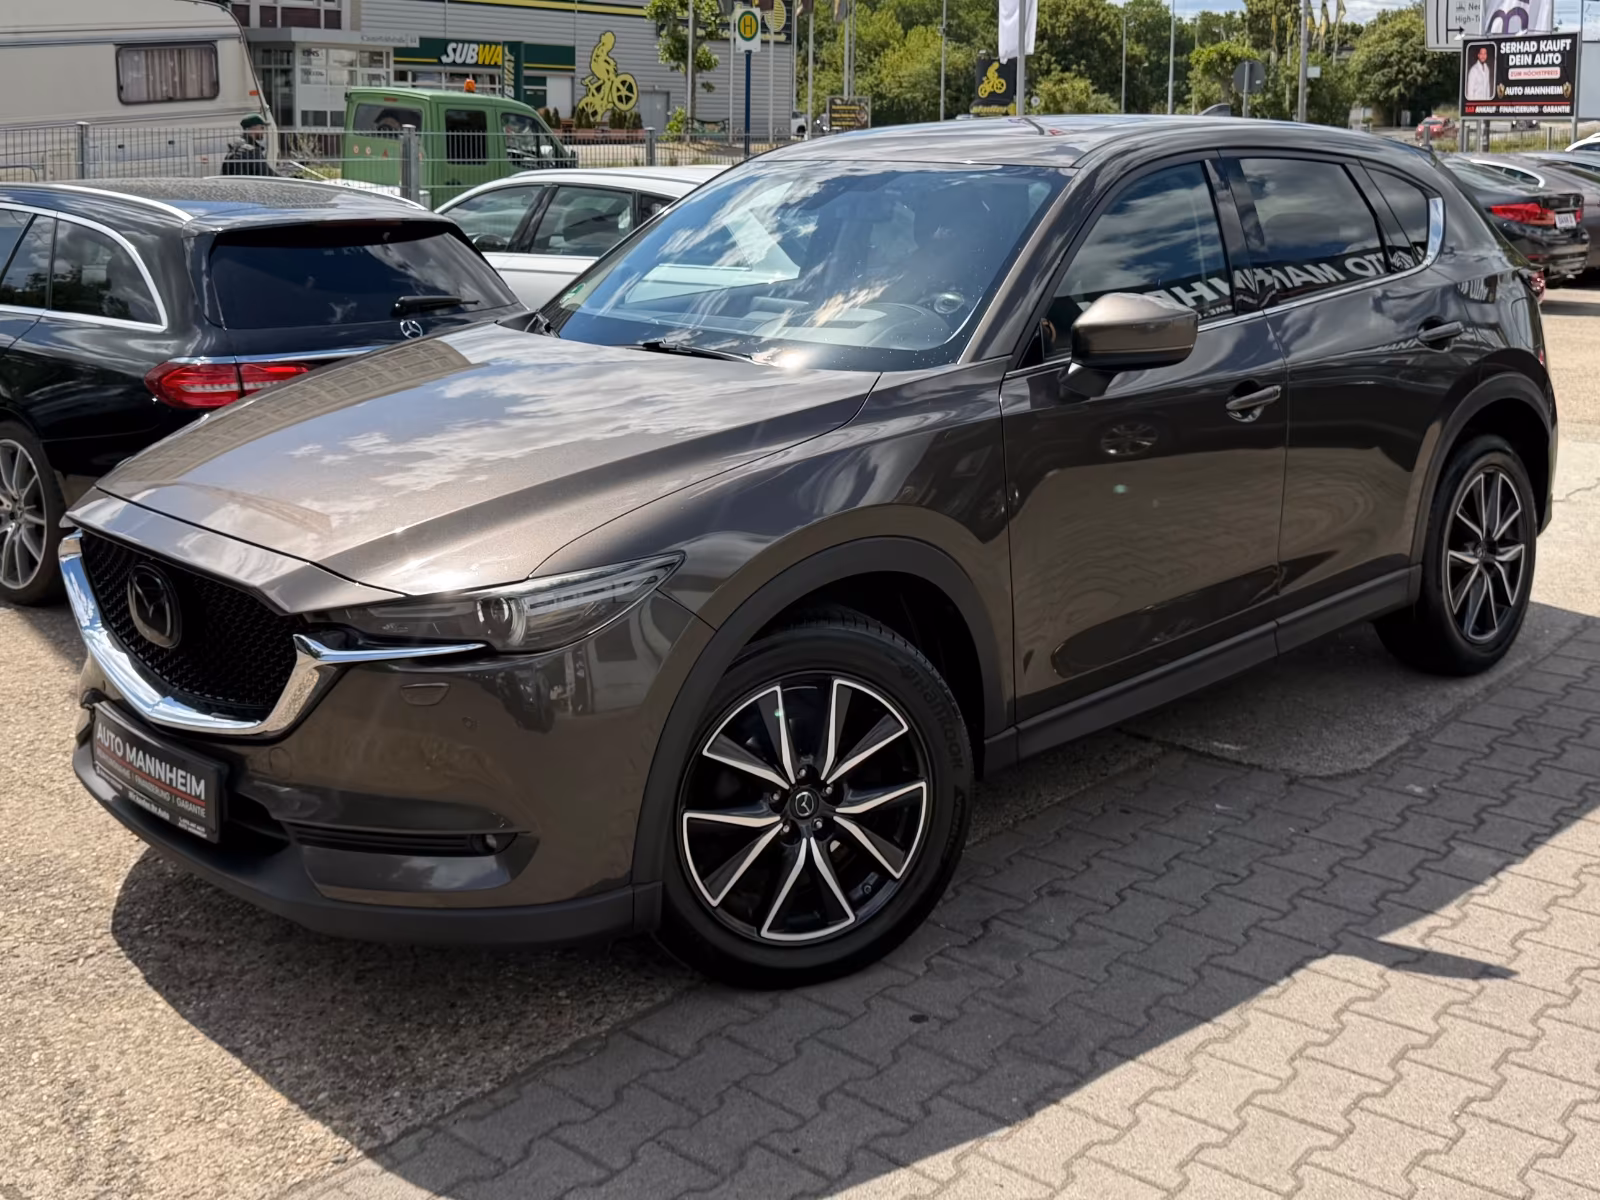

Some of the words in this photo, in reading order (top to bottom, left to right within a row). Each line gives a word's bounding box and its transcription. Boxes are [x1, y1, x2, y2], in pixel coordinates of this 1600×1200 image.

[440, 42, 503, 66] SUBWA
[1500, 40, 1537, 54] SERHAD
[1539, 38, 1572, 52] KAUFT
[1508, 54, 1533, 66] DEIN
[1534, 53, 1562, 65] AUTO
[1504, 87, 1523, 96] AUTO
[1524, 85, 1564, 95] MANNHEIM
[96, 723, 124, 758] AUTO
[126, 742, 206, 800] MANNHEIM
[176, 797, 206, 818] GARANTIE
